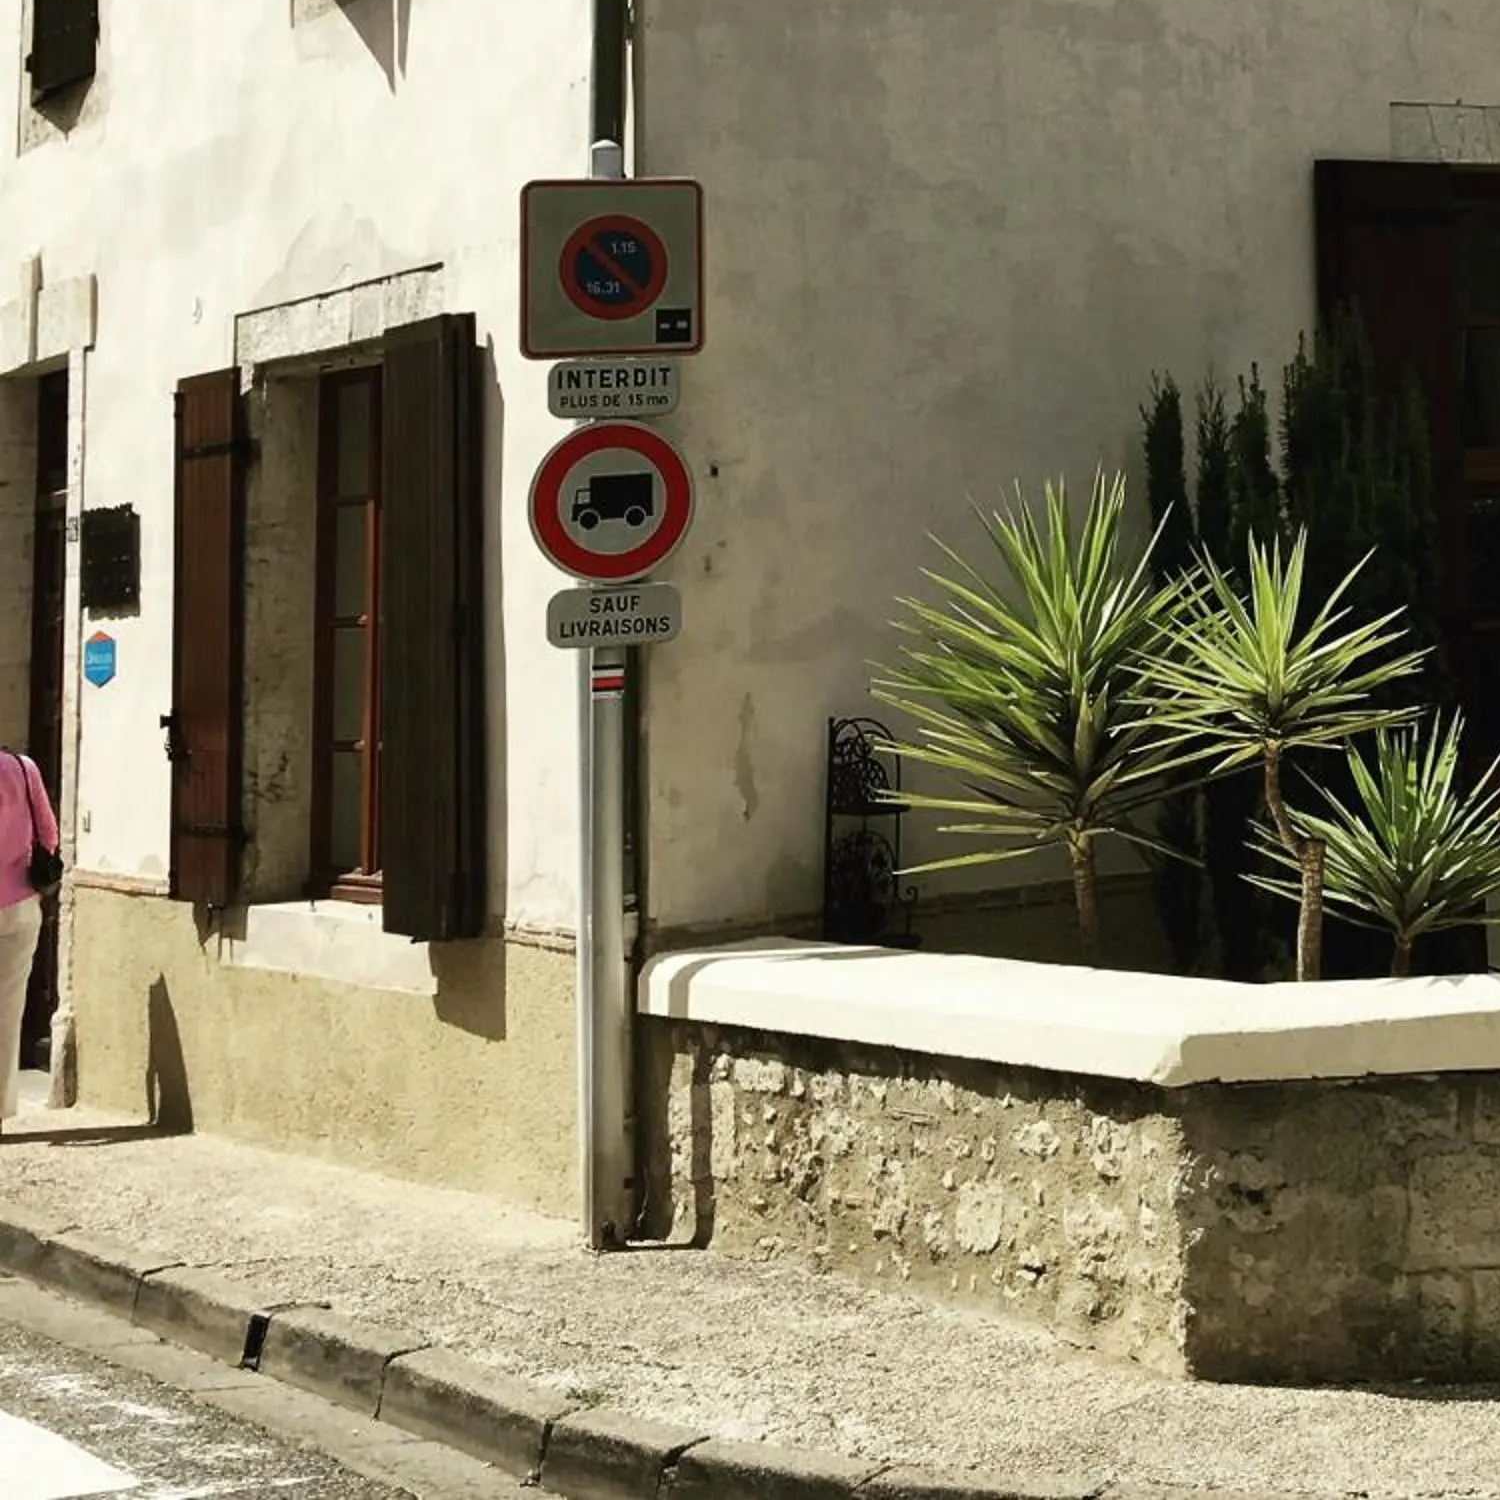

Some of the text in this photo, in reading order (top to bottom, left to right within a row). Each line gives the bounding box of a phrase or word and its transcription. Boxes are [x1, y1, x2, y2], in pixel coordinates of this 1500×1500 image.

[557, 366, 671, 389] INTERDIT
[560, 395, 597, 408] PLUS
[602, 394, 621, 407] DE
[589, 595, 641, 614] SAUF
[560, 615, 671, 639] LIVRAISONS
